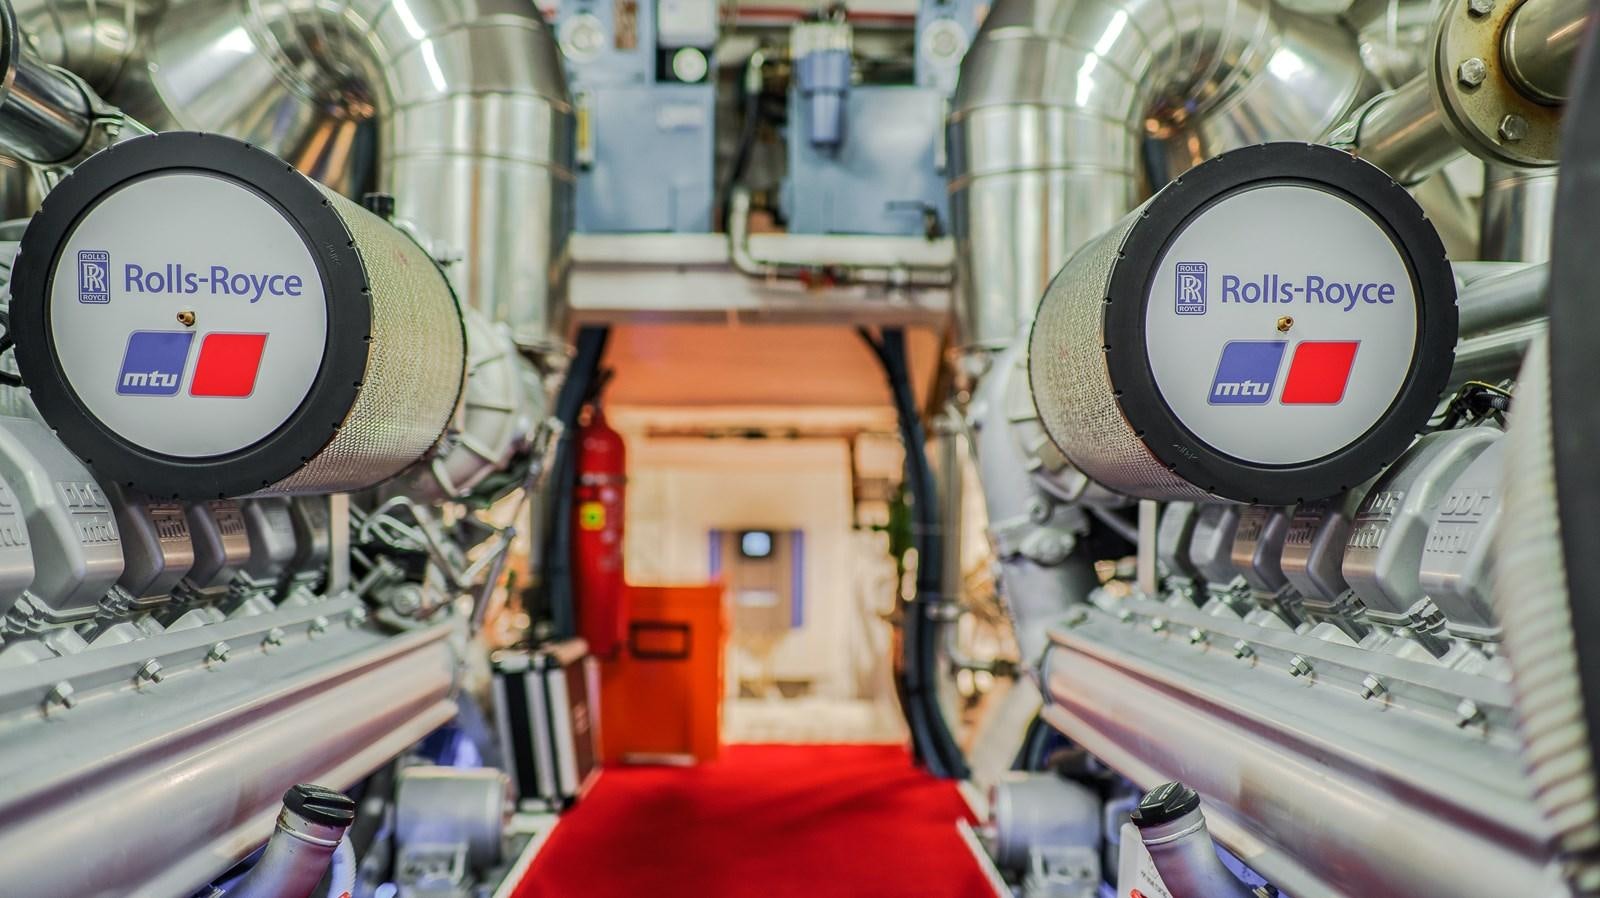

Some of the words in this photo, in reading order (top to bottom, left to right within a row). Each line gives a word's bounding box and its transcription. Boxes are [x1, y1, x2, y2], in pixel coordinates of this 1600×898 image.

[125, 263, 303, 303] Rolls-Royce
[1221, 274, 1395, 312] Rolls-Royce
[123, 370, 178, 387] mtu
[1214, 379, 1269, 396] mtu
